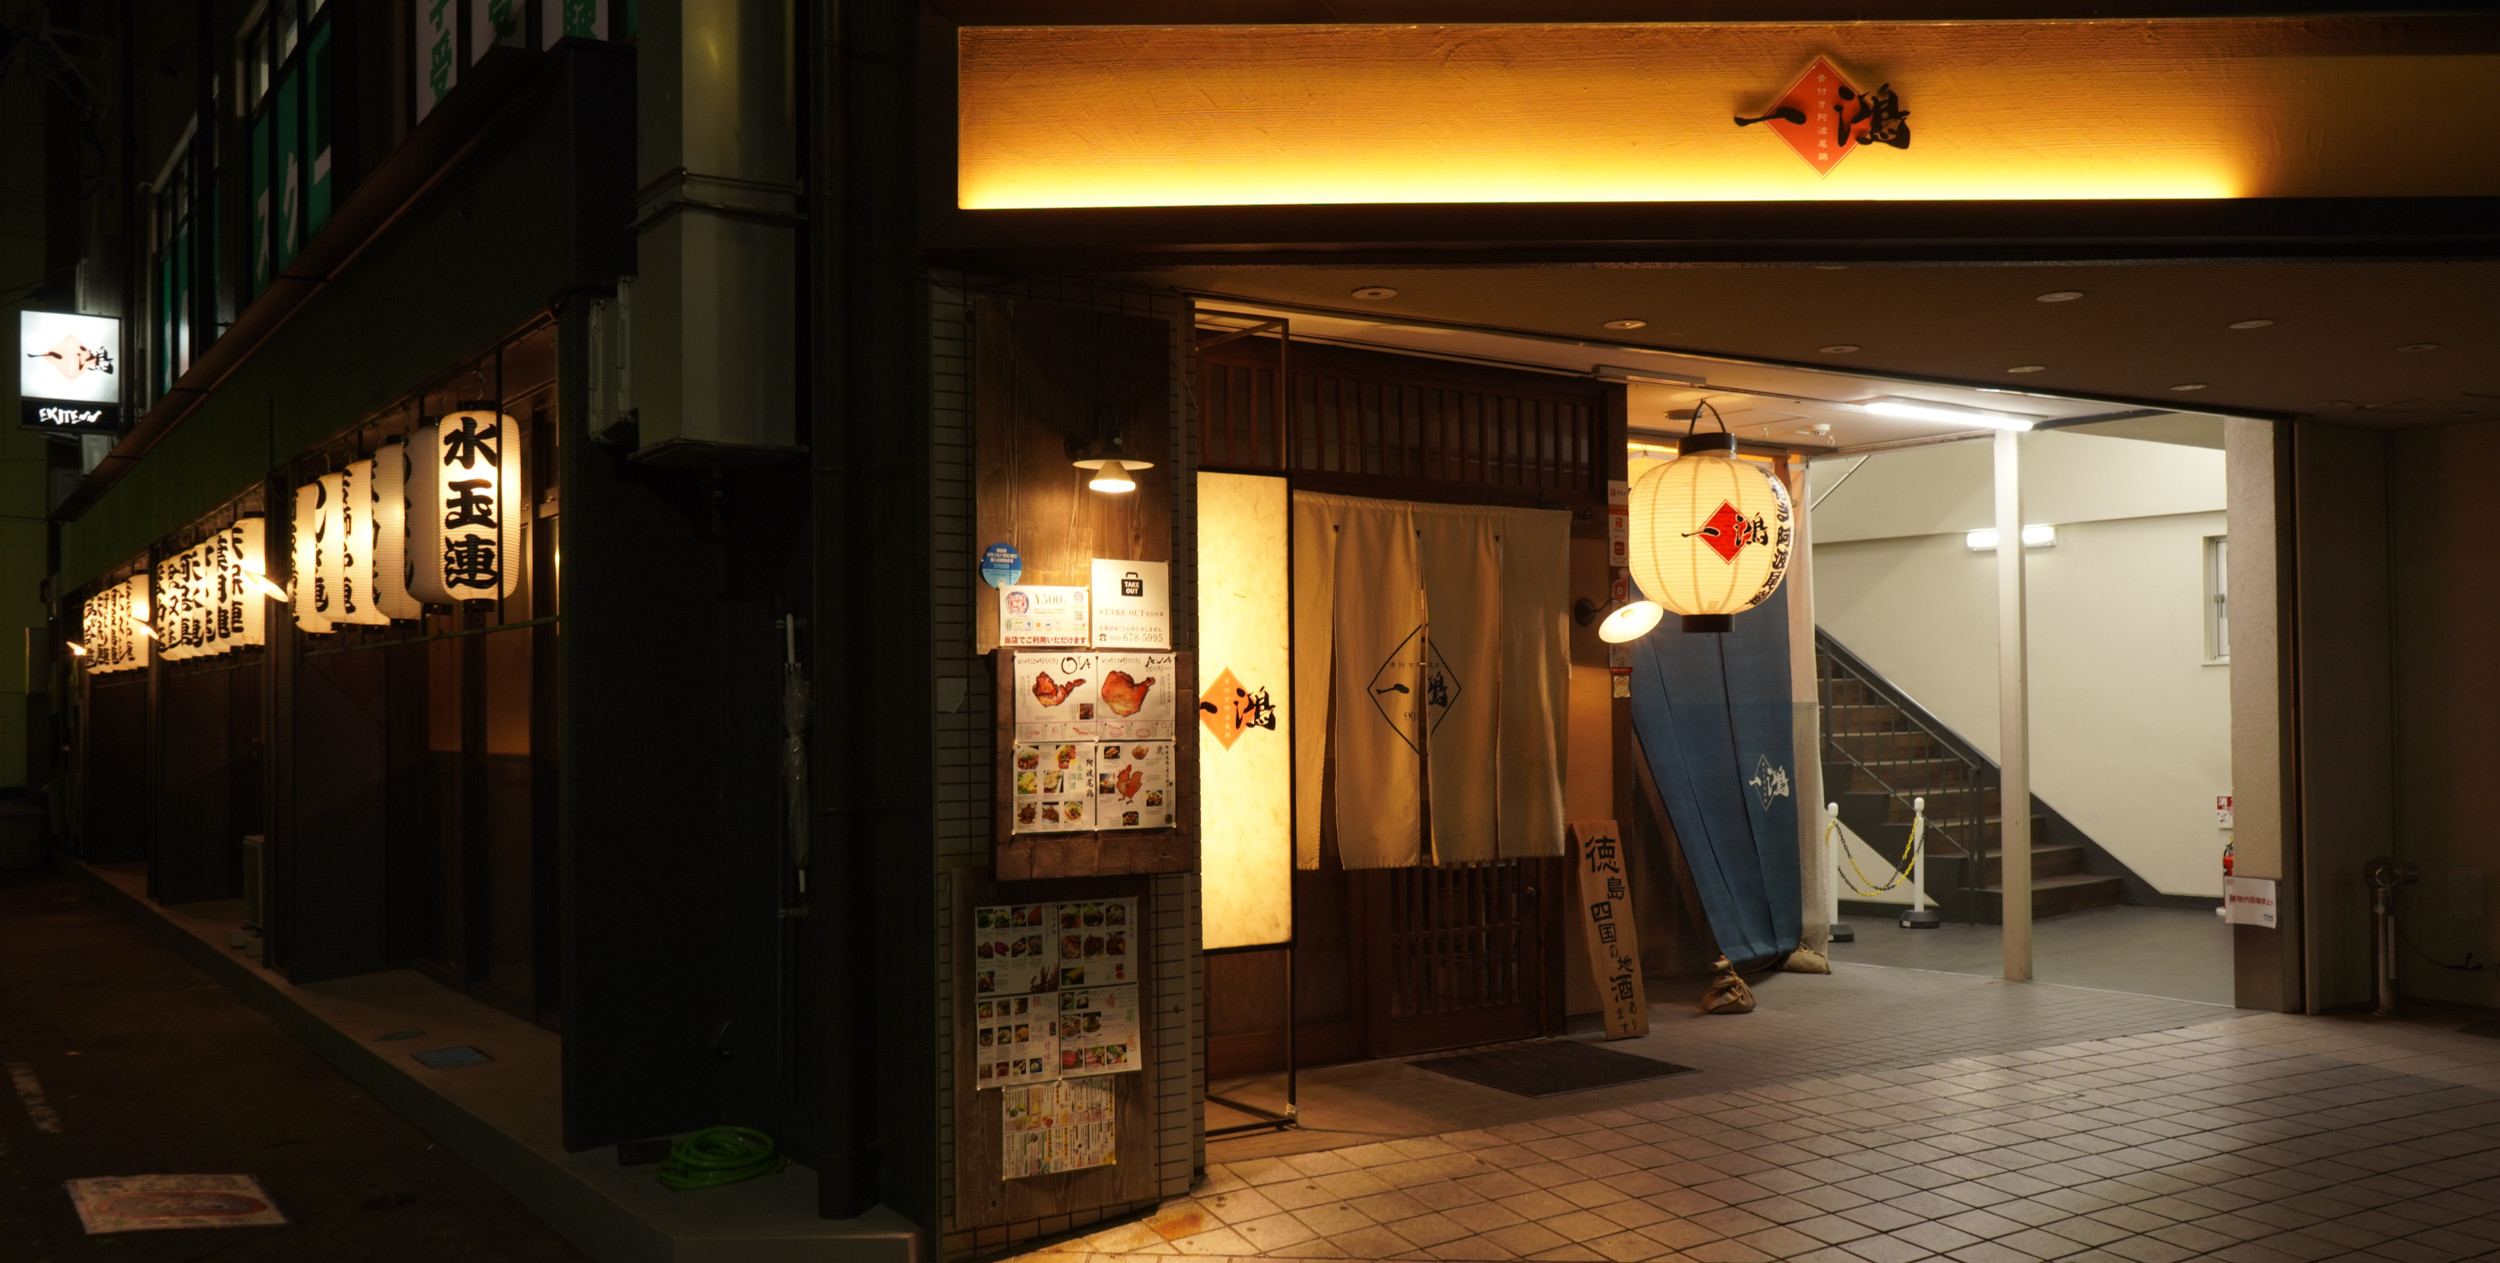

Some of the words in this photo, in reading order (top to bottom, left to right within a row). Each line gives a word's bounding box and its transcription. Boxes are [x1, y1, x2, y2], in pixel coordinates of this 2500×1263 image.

[1734, 83, 1911, 149] 一鴻
[27, 345, 114, 375] 一鴻
[443, 416, 499, 589] 水玉連
[1681, 512, 1769, 547] 一鴻
[1104, 608, 1125, 616] TAKE
[1004, 635, 1087, 645] 当店でご利用いただけます
